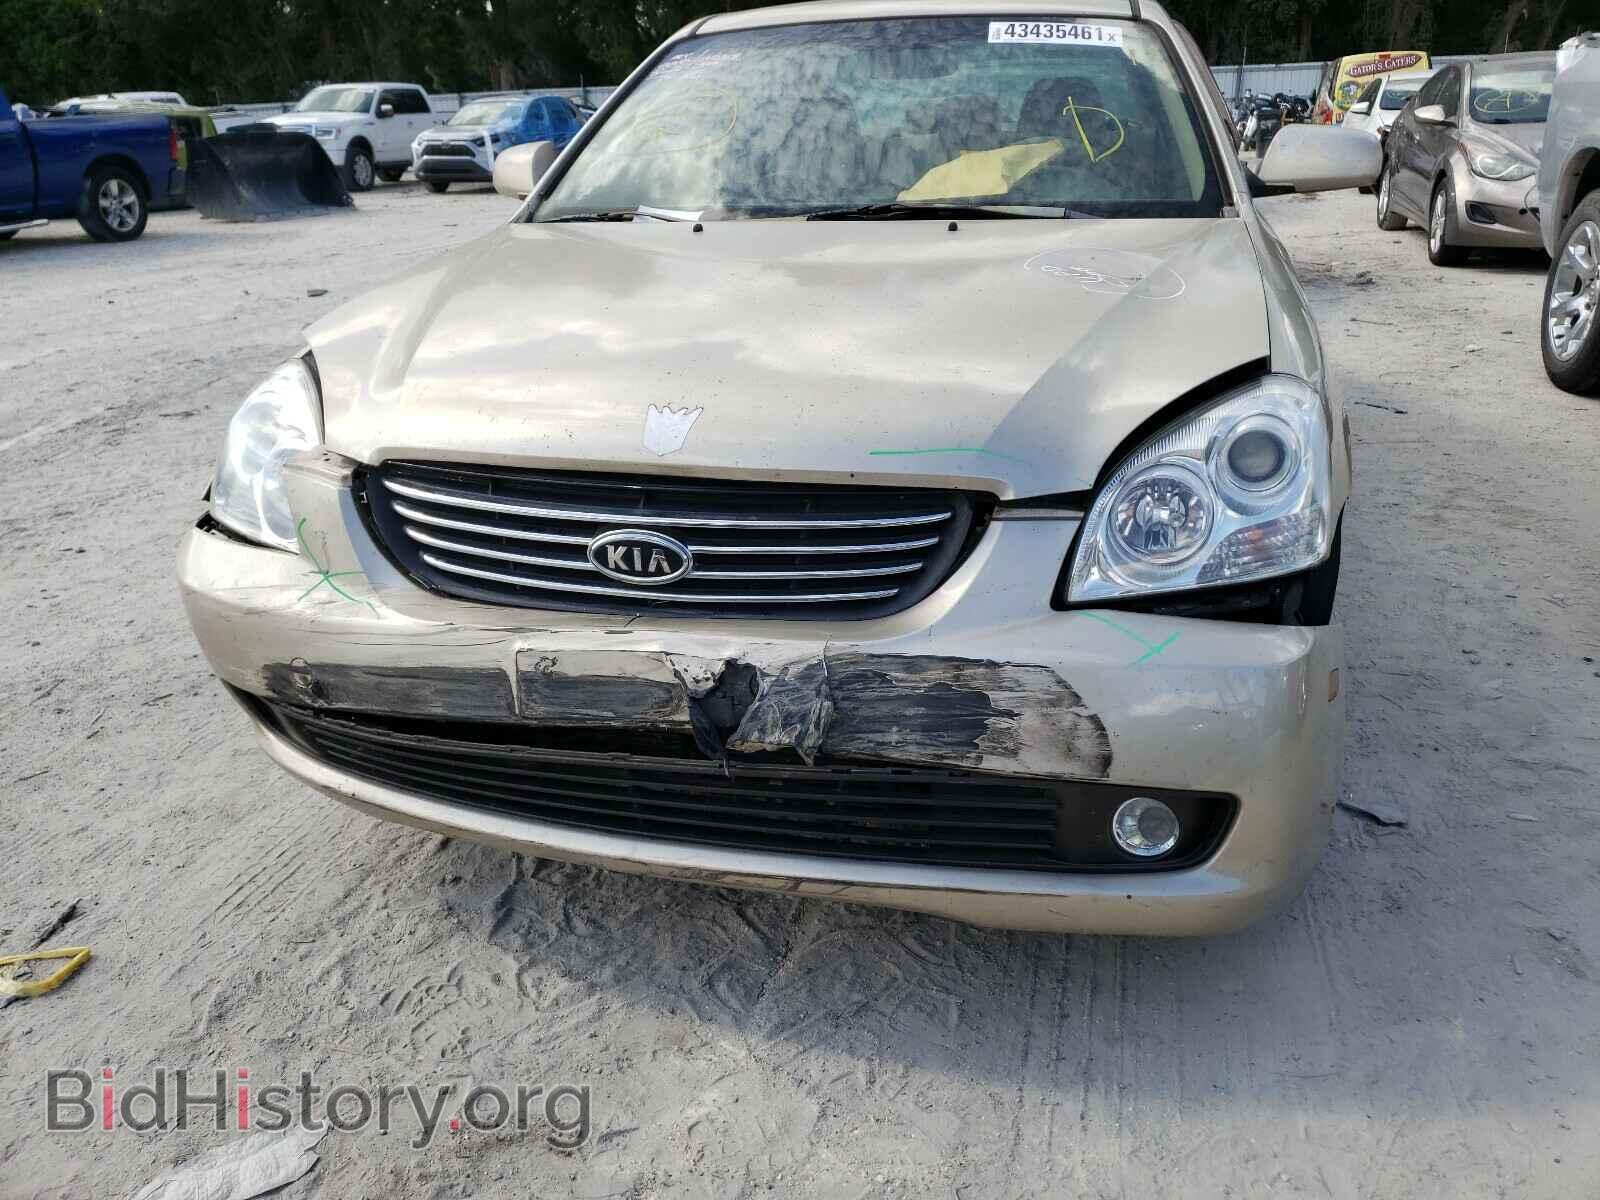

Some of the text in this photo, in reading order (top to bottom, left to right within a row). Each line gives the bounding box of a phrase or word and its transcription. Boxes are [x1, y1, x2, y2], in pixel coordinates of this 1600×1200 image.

[1004, 23, 1103, 41] 43435461
[1062, 96, 1125, 163] D
[606, 544, 671, 573] KIA
